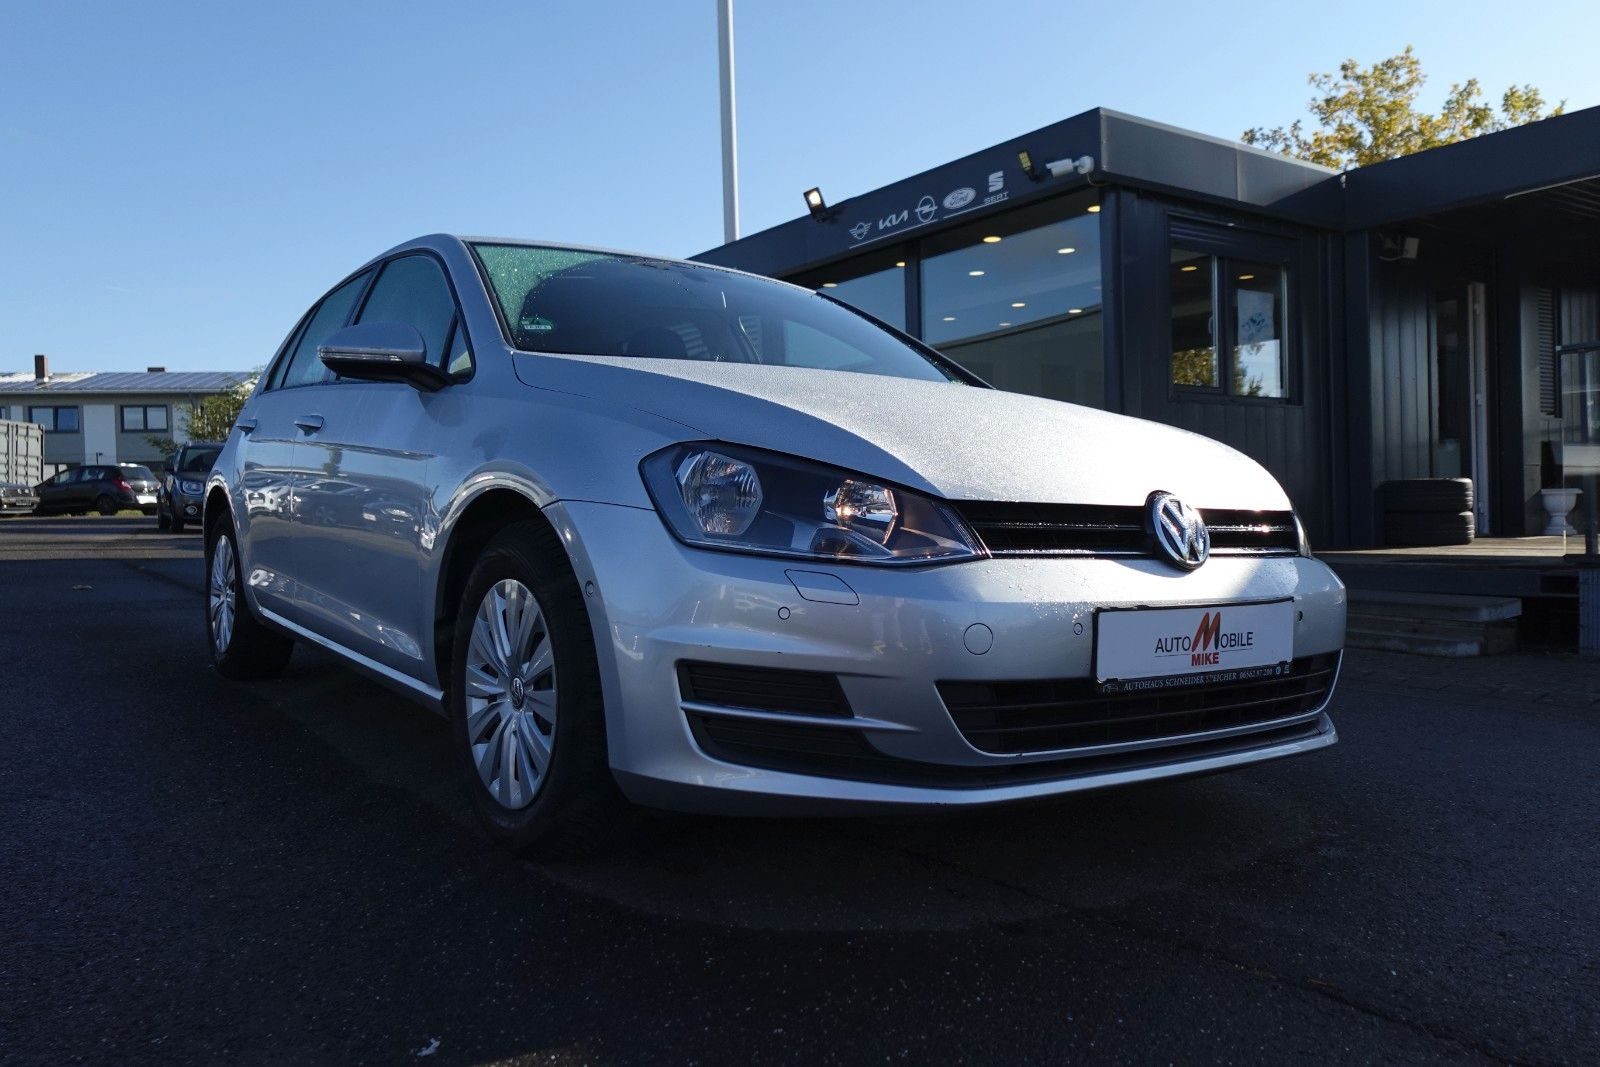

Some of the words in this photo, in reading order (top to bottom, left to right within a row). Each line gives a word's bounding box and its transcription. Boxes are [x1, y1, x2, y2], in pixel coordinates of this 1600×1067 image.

[1191, 651, 1220, 667] MIKE
[1123, 678, 1164, 692] AUTOHAUS
[1165, 674, 1205, 688] SCHNEIDER
